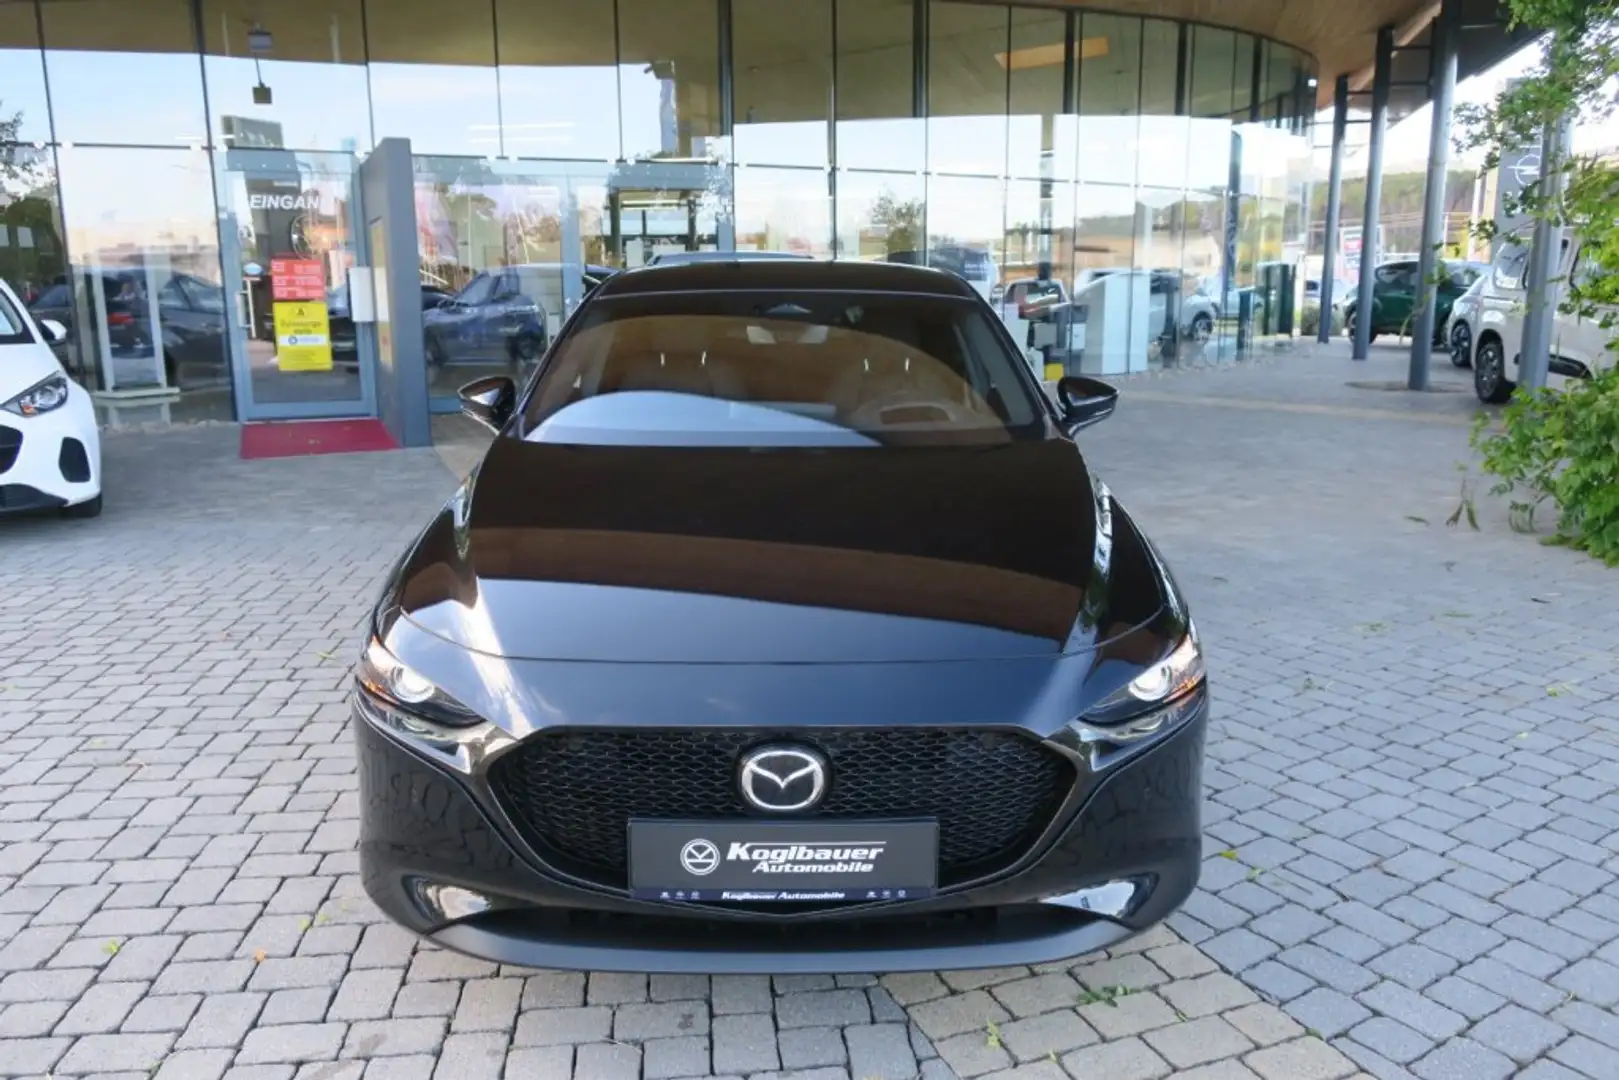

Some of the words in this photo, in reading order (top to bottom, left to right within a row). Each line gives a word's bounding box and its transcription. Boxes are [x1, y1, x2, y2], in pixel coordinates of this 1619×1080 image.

[250, 194, 330, 210] EINGAN
[726, 841, 885, 864] Koglbauer
[752, 861, 874, 873] Automobile
